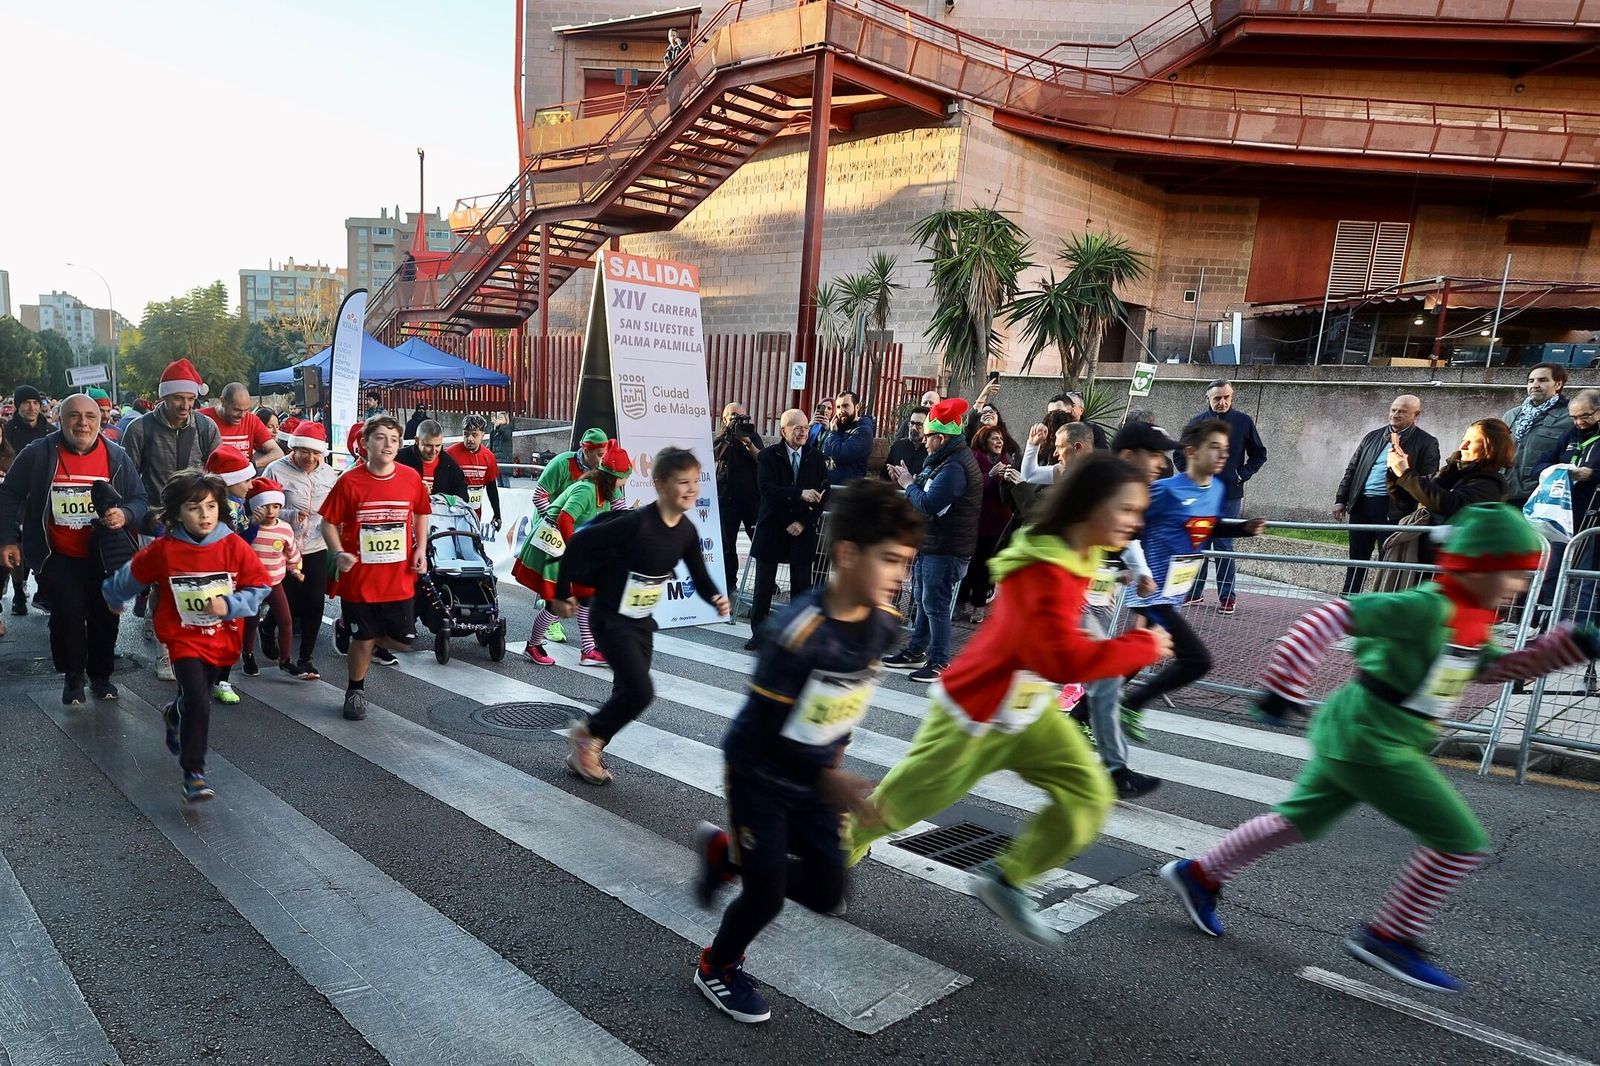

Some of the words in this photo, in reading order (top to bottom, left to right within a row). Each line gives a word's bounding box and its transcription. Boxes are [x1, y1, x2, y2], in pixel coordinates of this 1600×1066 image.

[610, 256, 695, 288] SALIDA
[612, 287, 647, 311] XIV
[651, 302, 698, 318] CARRERA
[619, 318, 641, 331] SAN
[644, 321, 695, 337] SILVESTRE
[614, 334, 651, 348] PALMA
[653, 338, 703, 353] PALMILLA
[652, 386, 690, 399] Ciudad
[653, 402, 667, 413] de
[670, 402, 707, 418] Málaga
[61, 502, 96, 514] 1016
[368, 539, 400, 552] 1022
[539, 530, 563, 549] 1009
